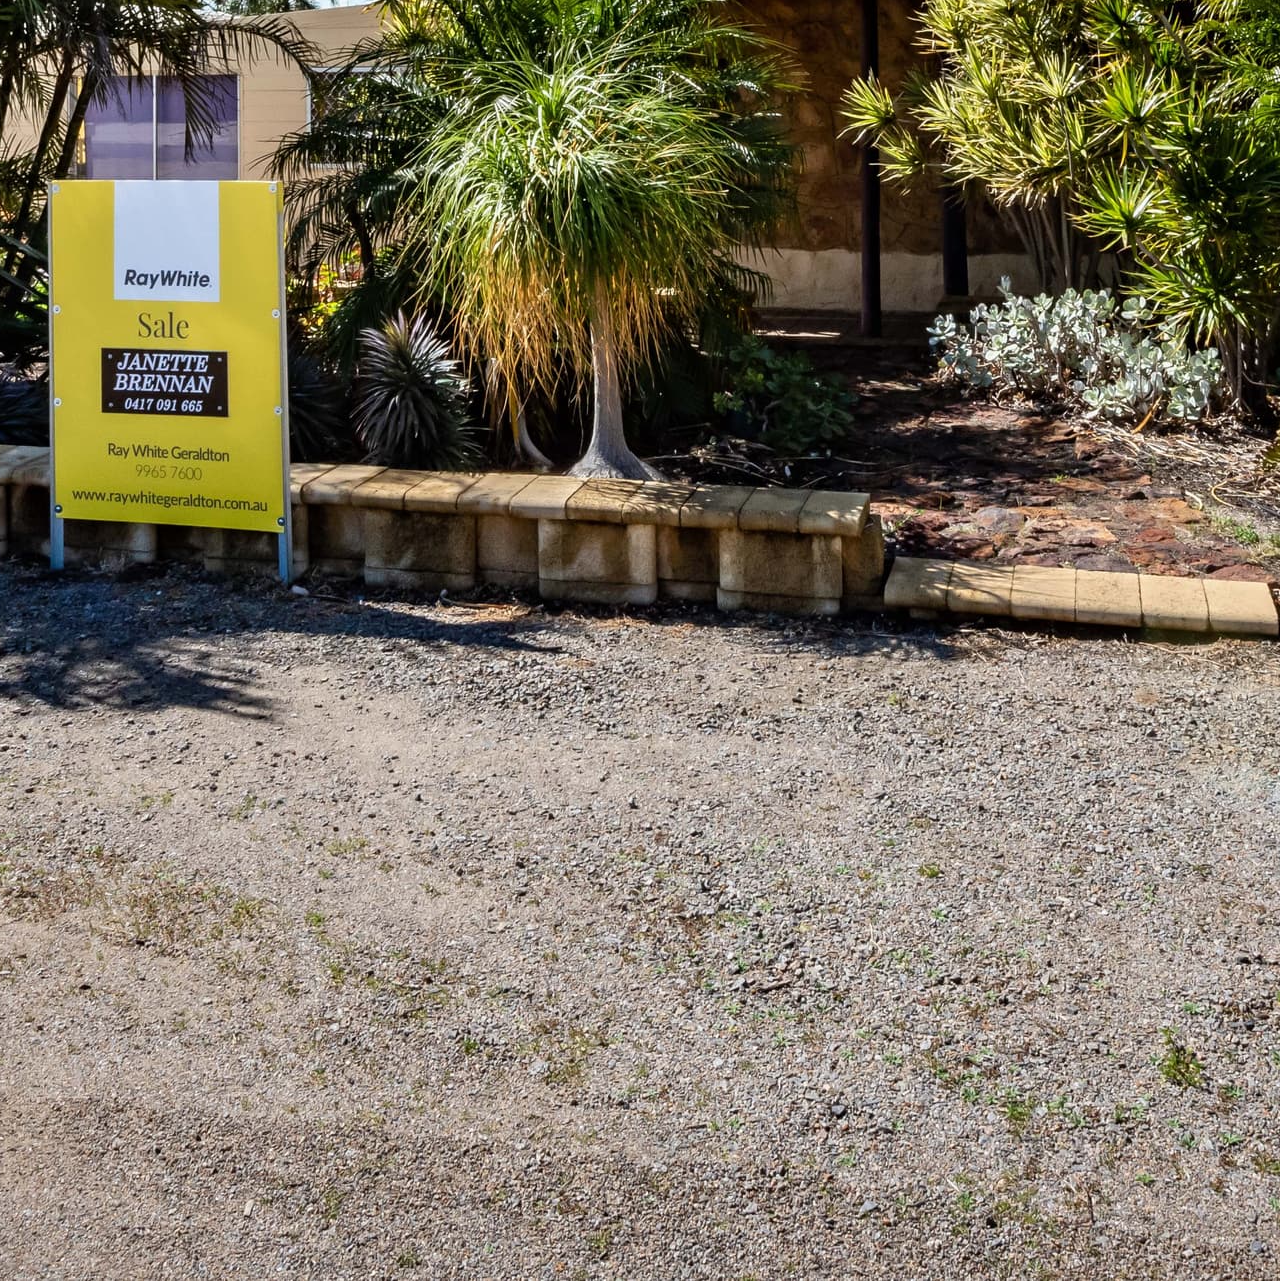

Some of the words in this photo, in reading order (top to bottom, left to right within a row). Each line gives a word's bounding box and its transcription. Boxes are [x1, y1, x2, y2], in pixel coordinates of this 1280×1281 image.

[138, 311, 189, 340] Sale
[117, 353, 209, 373] JANETTE
[113, 373, 214, 394] BRENNAN
[124, 398, 153, 410] 0417
[156, 398, 177, 412] 091
[181, 399, 203, 413] 665
[108, 443, 129, 460] Ray
[132, 444, 169, 459] White
[171, 446, 230, 462] Geraldton
[135, 464, 166, 479] 9965
[171, 466, 202, 481] 7600
[72, 490, 268, 512] www.raywhitegeraldton.com.au
